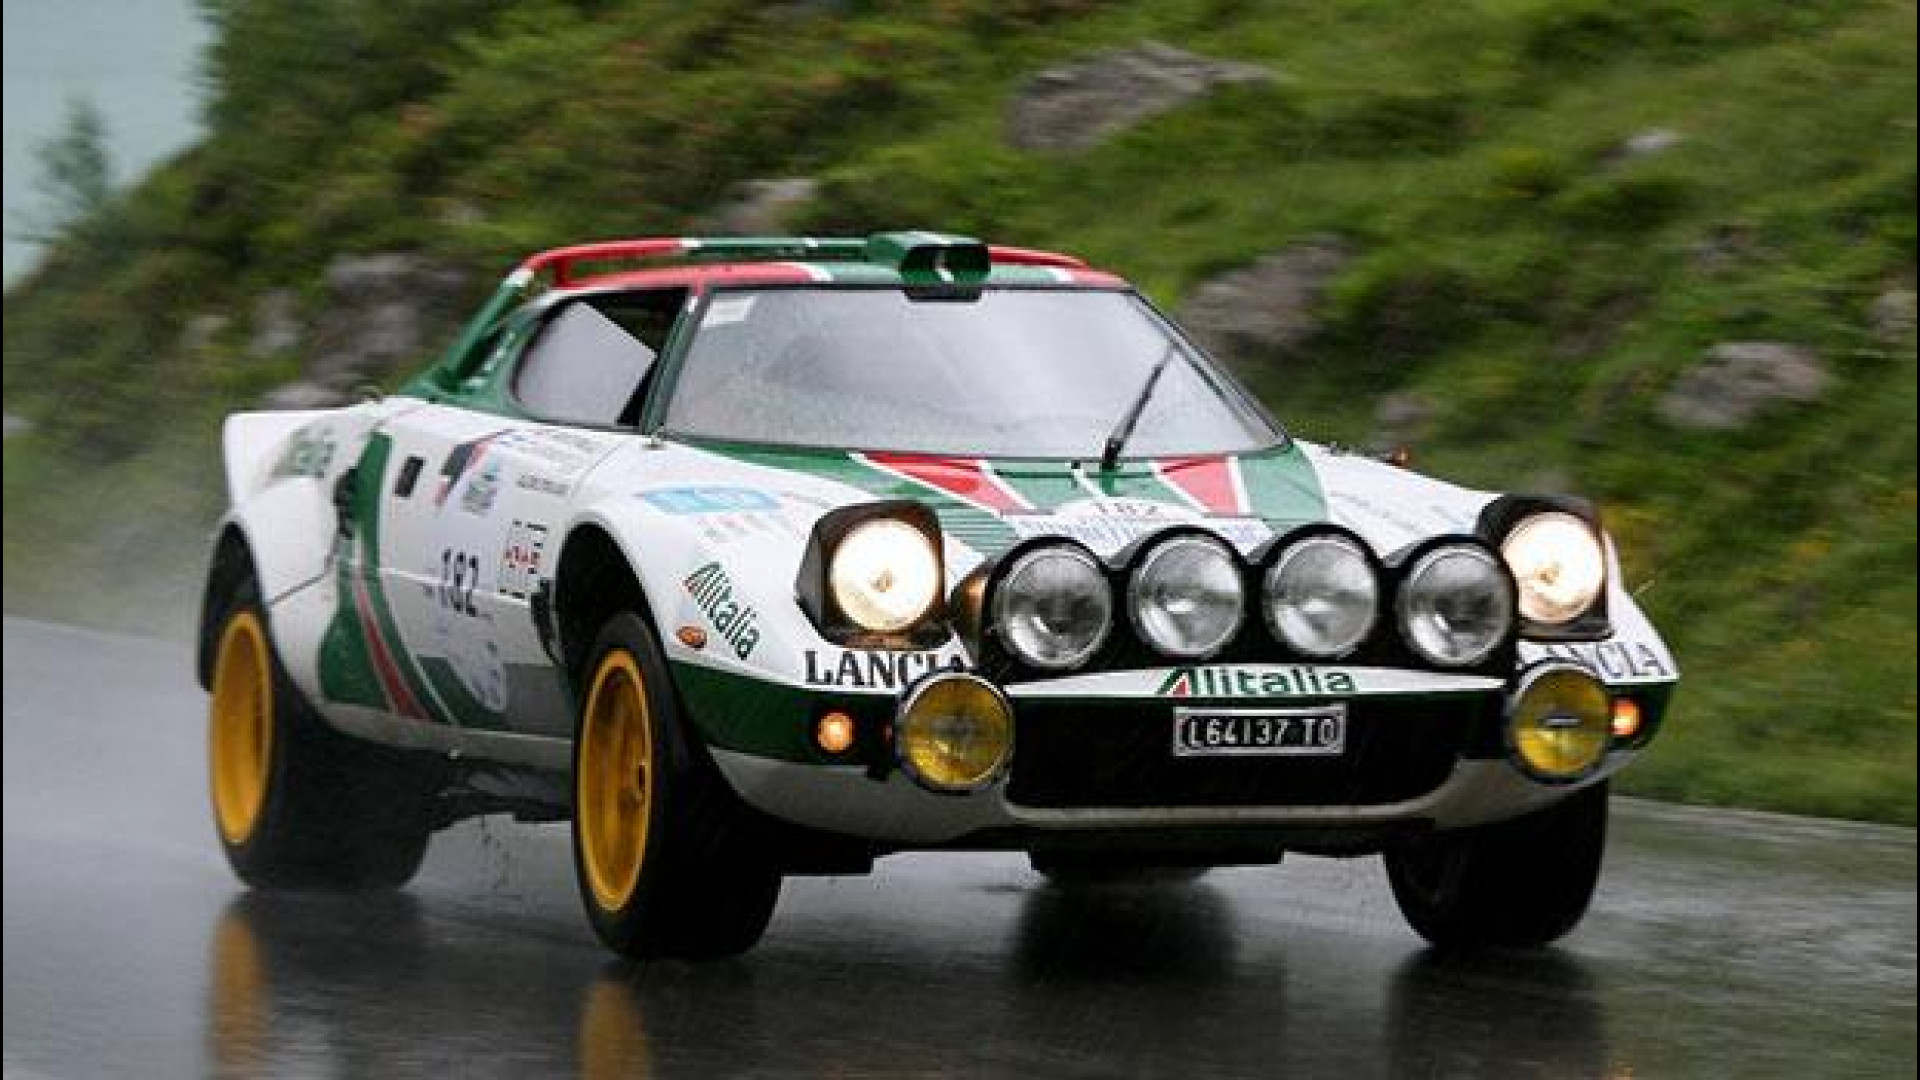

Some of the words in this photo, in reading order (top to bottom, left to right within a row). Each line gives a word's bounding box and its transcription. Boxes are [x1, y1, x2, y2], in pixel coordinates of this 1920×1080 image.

[683, 561, 761, 661] Alitalia
[1540, 641, 1670, 678] NCIA
[1155, 667, 1356, 697] Alitalia
[1186, 717, 1290, 746] L64137
[1302, 717, 1337, 746] TO
